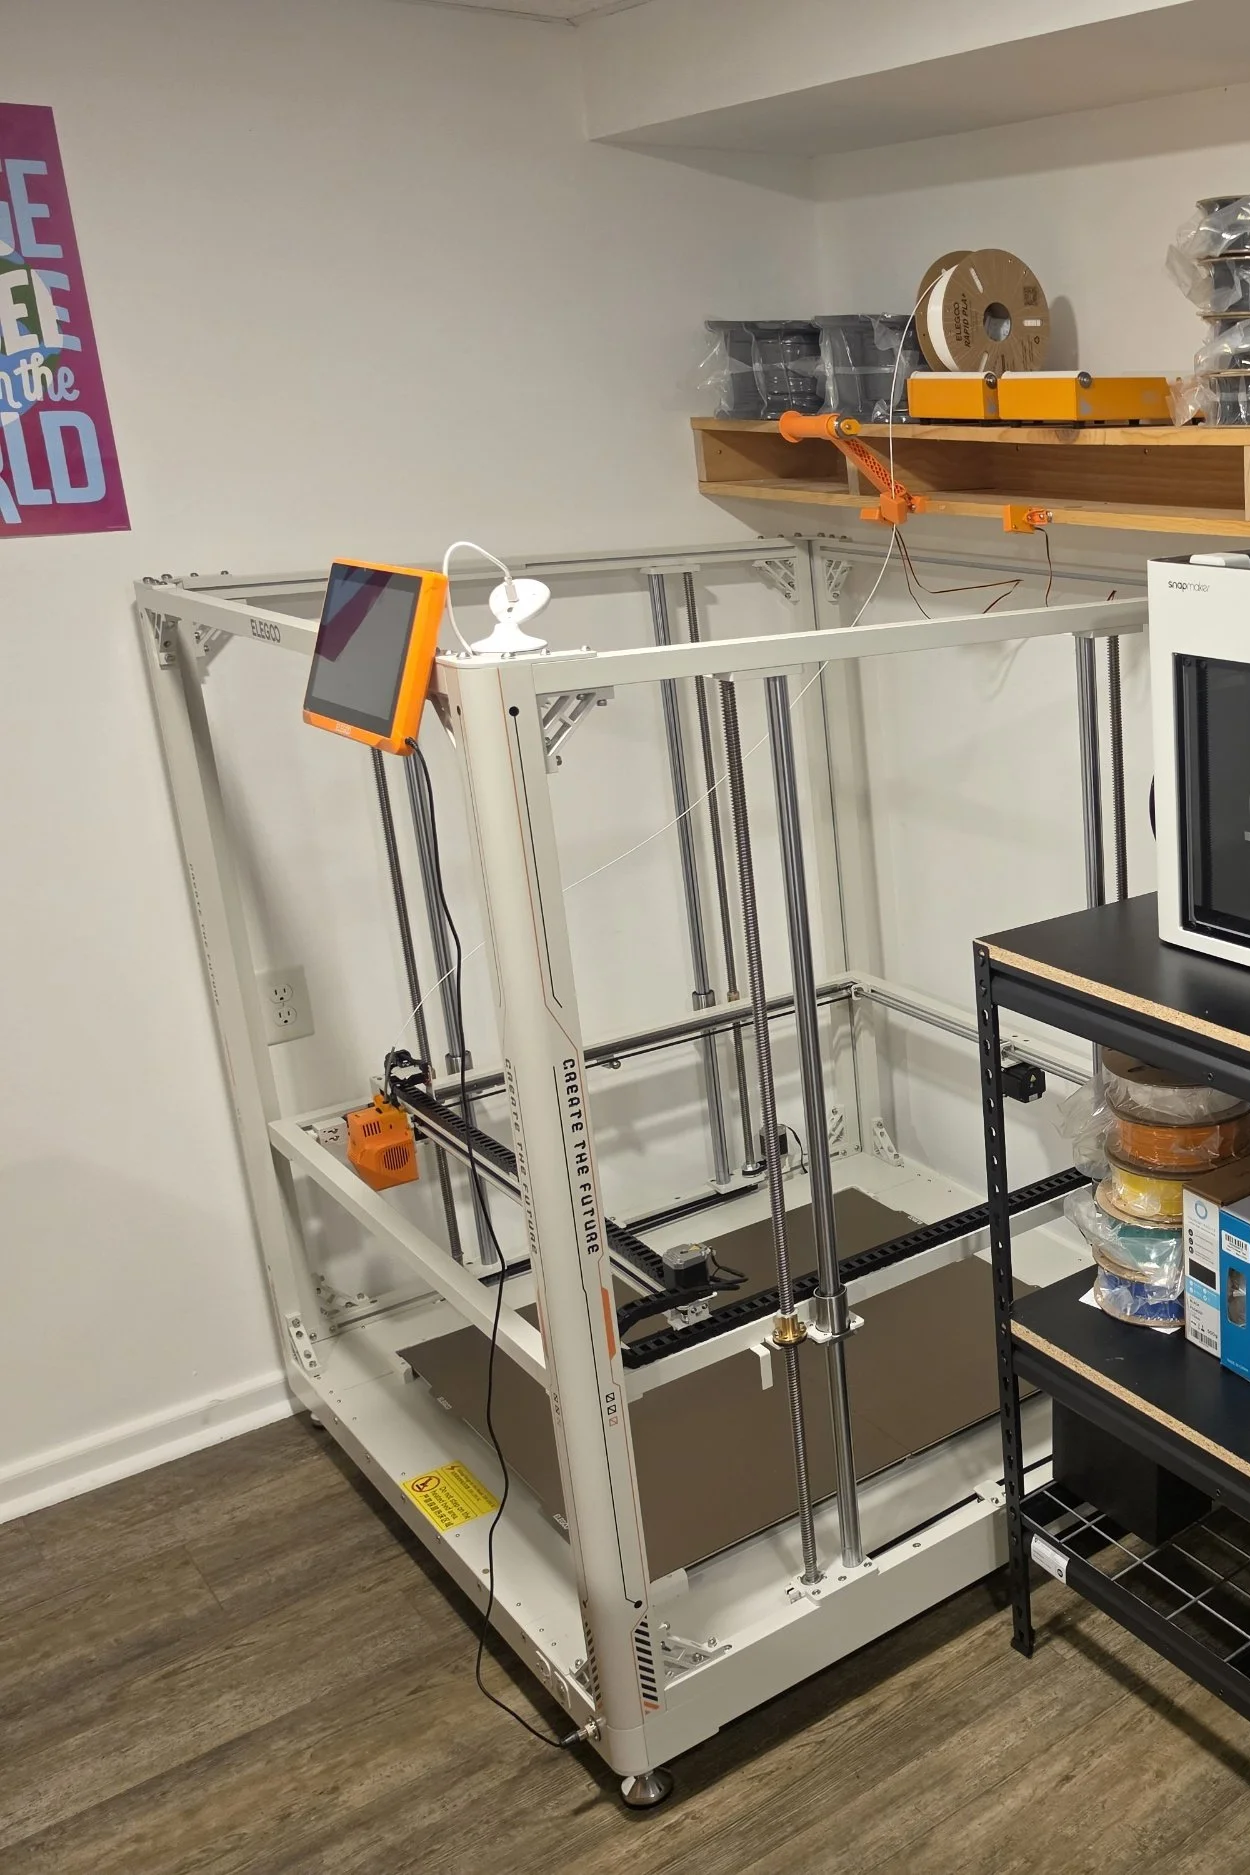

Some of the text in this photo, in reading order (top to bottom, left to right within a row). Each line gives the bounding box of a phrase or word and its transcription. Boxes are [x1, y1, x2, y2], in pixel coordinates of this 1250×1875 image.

[953, 301, 963, 342] ELEGOO
[961, 319, 971, 349] RAPID
[14, 352, 80, 402] the
[0, 408, 108, 524] LD
[1168, 580, 1210, 593] snapmaker
[250, 618, 281, 644] ELEGOO
[504, 1058, 521, 1133] CREATE
[517, 1141, 527, 1178] THE
[563, 1057, 601, 1256] CREATE THE FUTURE
